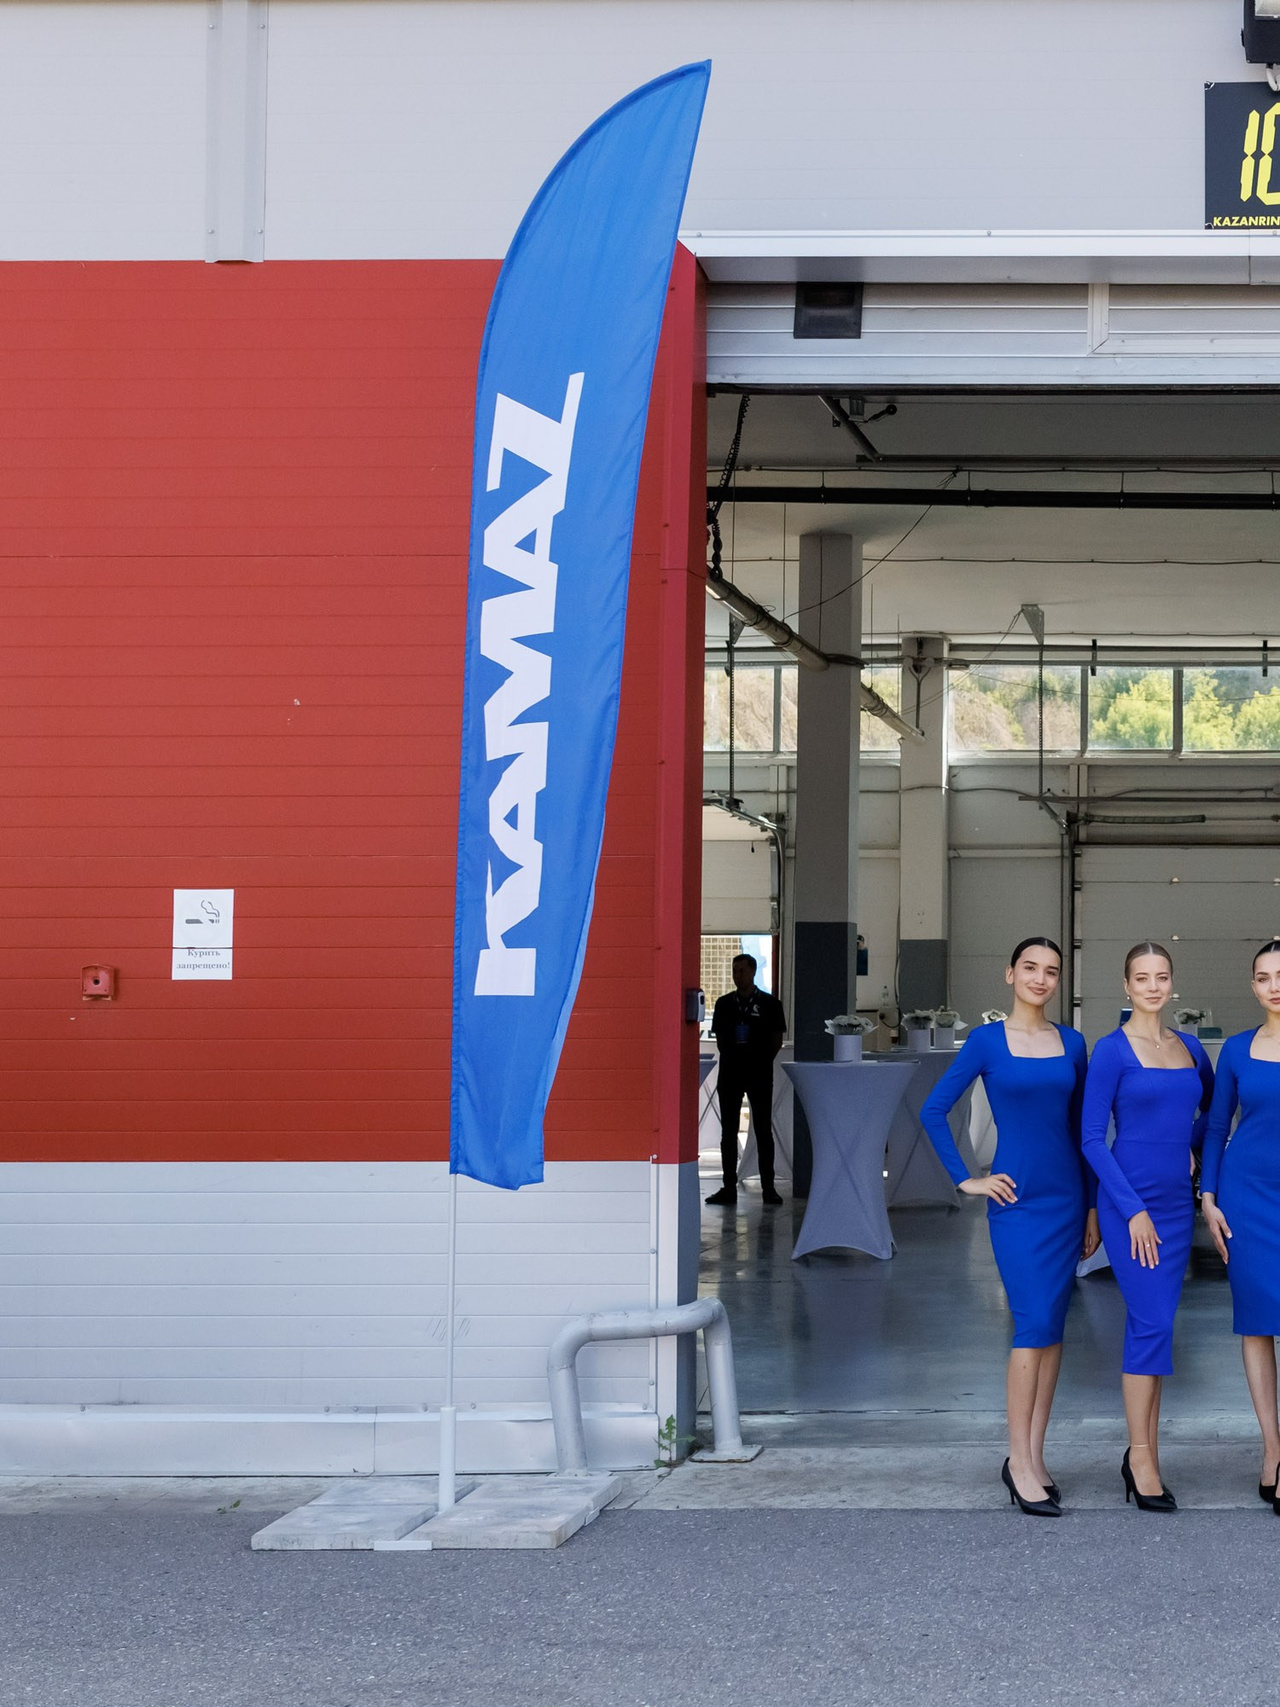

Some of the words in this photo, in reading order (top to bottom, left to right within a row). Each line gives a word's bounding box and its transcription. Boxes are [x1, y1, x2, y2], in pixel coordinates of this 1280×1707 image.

[475, 371, 585, 996] KAMAZ
[187, 949, 221, 957] Курить
[176, 962, 230, 970] запрещено!
